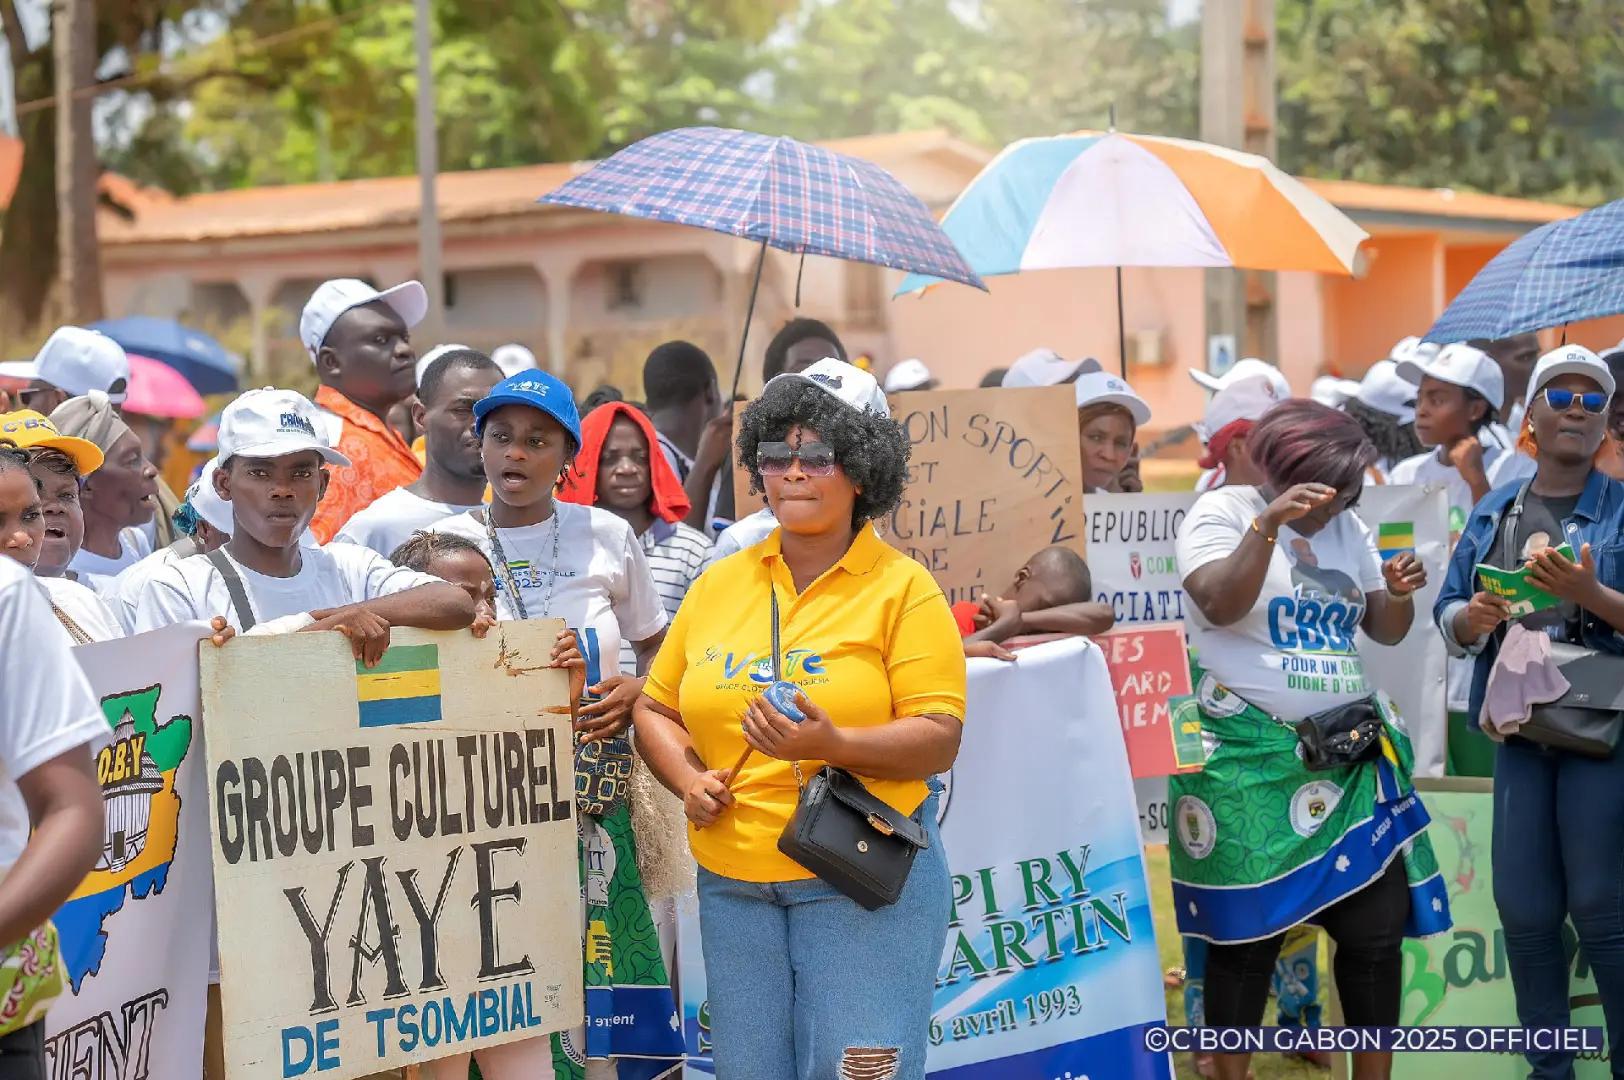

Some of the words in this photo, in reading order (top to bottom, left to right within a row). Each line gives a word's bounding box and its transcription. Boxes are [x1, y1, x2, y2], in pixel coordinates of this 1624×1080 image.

[884, 498, 997, 540] CiALE
[1083, 508, 1186, 543] EPUBLI
[1096, 636, 1145, 664] ES
[1282, 657, 1317, 674] POUR
[1321, 661, 1338, 675] UN
[1113, 671, 1172, 696] ARD
[216, 746, 374, 864] GROUPE
[389, 728, 571, 842] CULTUREL
[1015, 844, 1090, 912] RY
[284, 838, 535, 1016] YAYE
[282, 1020, 341, 1078] DE
[366, 981, 542, 1058] TSOMBIAL
[952, 1000, 1017, 1037] avril
[1024, 984, 1083, 1023] 1993
